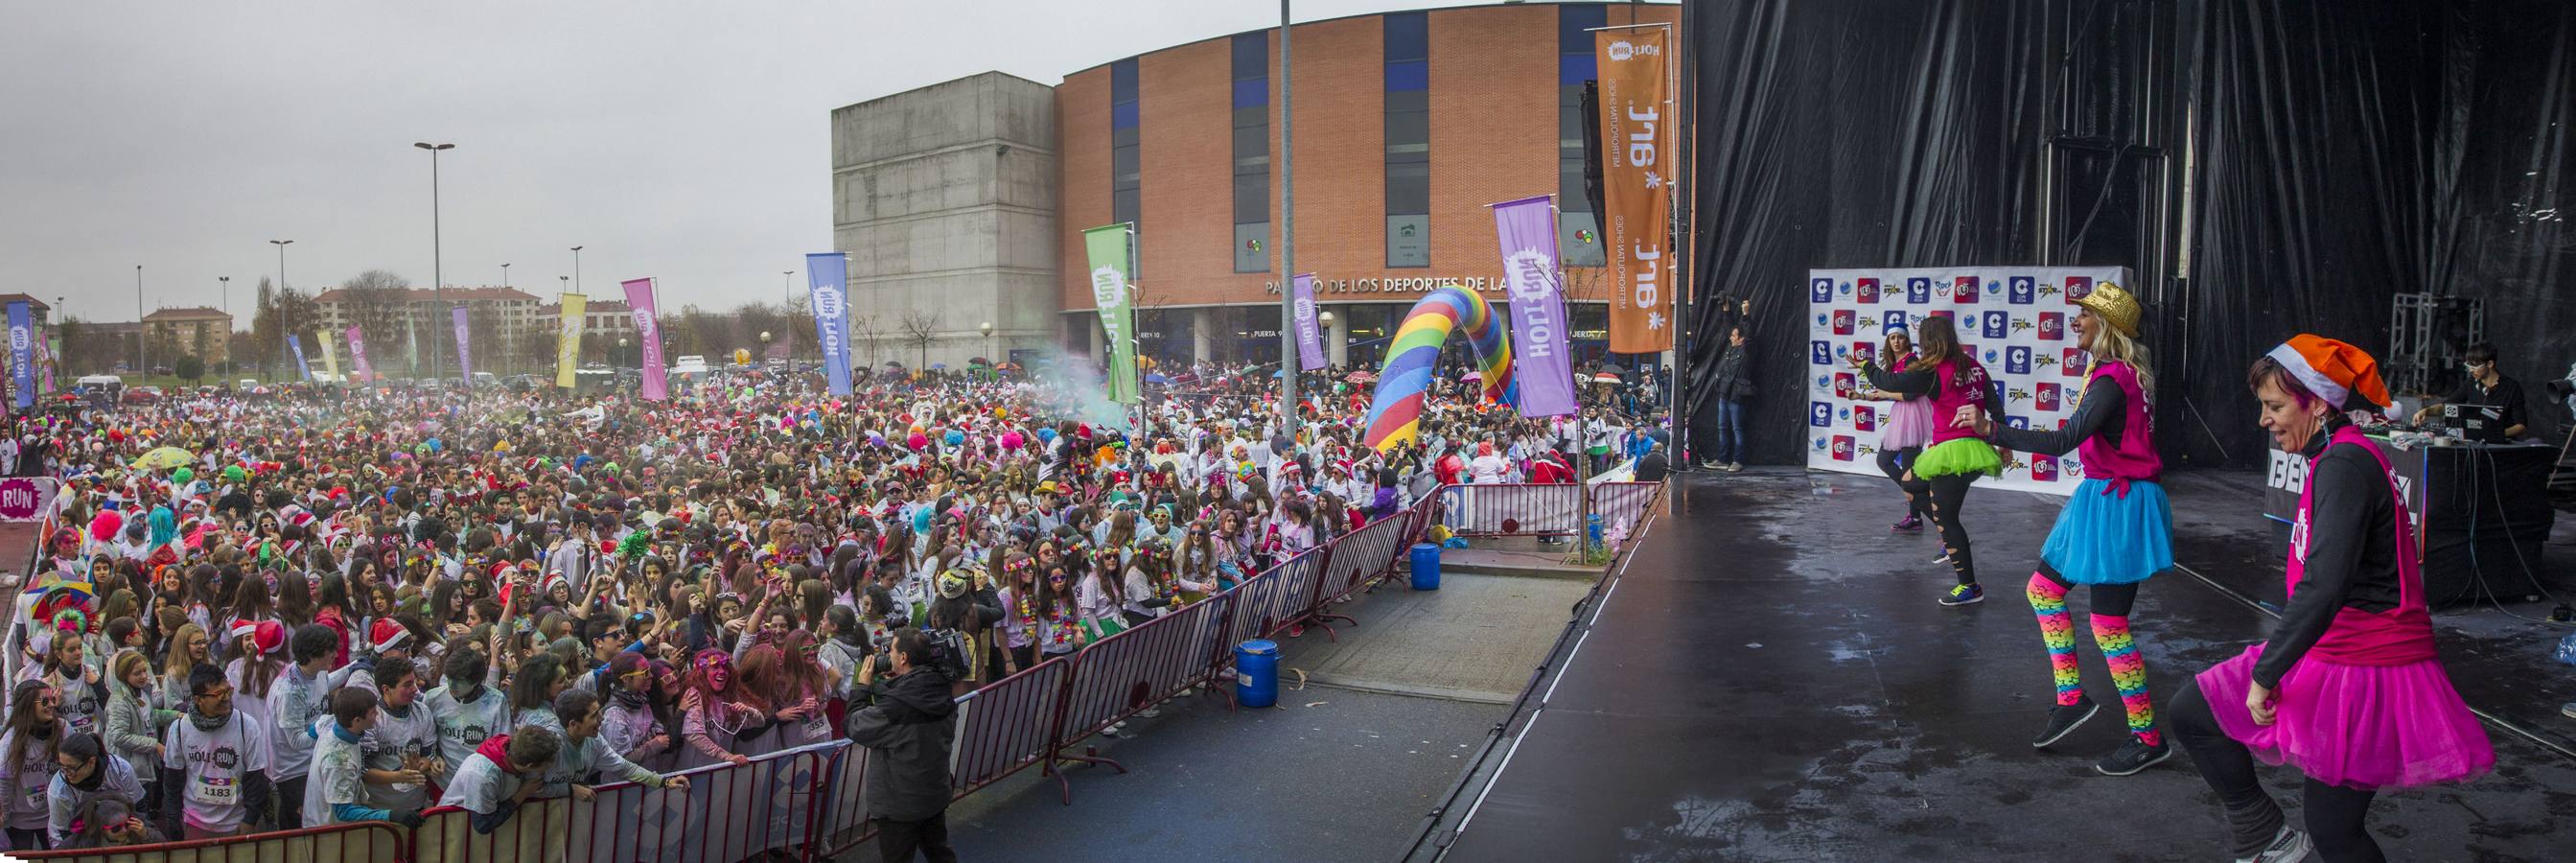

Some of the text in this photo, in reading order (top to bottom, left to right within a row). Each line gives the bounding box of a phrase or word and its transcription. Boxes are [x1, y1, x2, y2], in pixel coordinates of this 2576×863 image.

[1329, 279, 1346, 292] DE
[1352, 278, 1379, 292] LOS
[1383, 277, 1458, 292] DEPORTES
[1465, 276, 1485, 291] DE
[1490, 278, 1507, 292] LA
[1935, 280, 1952, 291] Rock
[3, 488, 33, 509] RUN
[445, 727, 484, 741] OLI RUN
[189, 751, 235, 764] HOLI RUN
[204, 787, 230, 798] 1183
